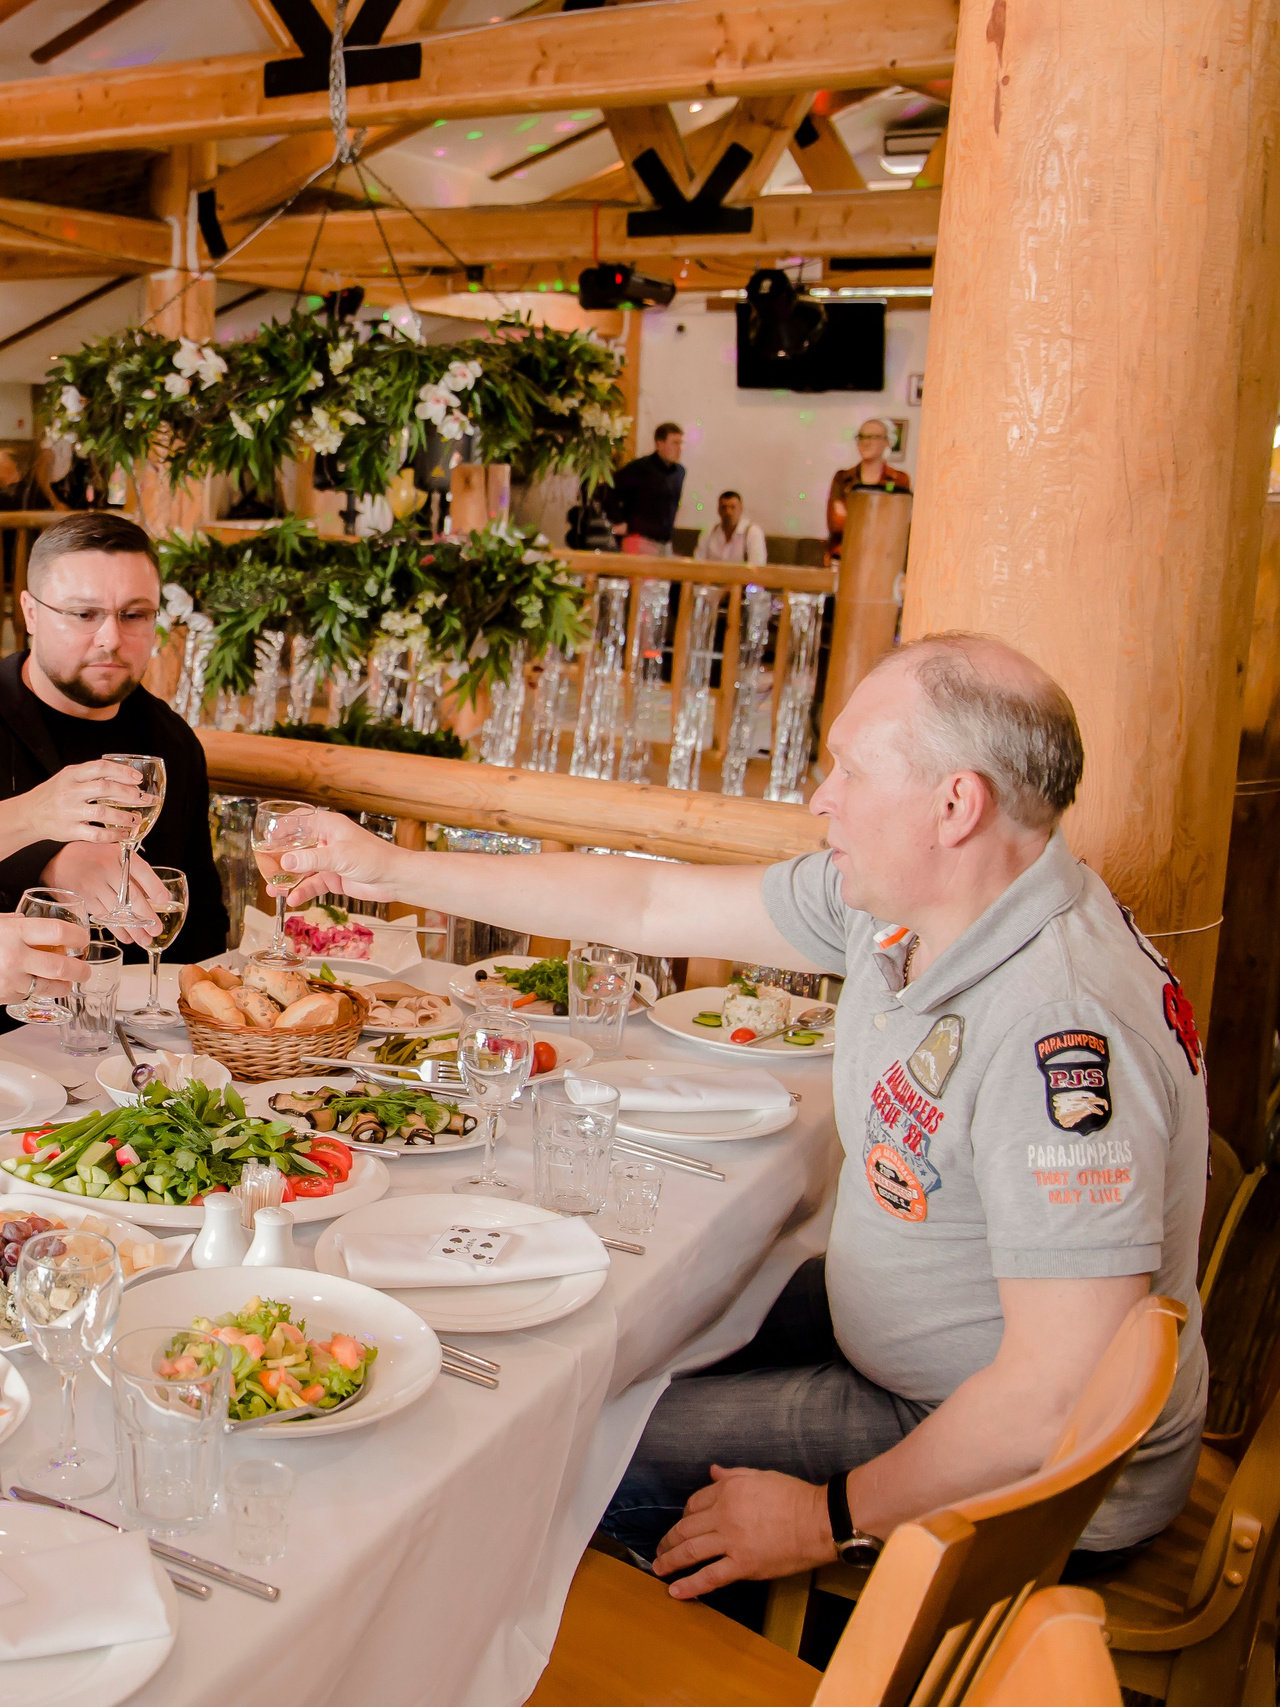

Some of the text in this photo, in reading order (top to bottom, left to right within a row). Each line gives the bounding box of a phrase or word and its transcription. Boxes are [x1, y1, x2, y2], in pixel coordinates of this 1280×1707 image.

[1038, 1033, 1106, 1059] PARAJUMPERS
[1027, 1139, 1133, 1168] PARAJUMPERS
[1032, 1167, 1132, 1187] THAT OTHERS
[1048, 1187, 1123, 1204] MAY LIVE
